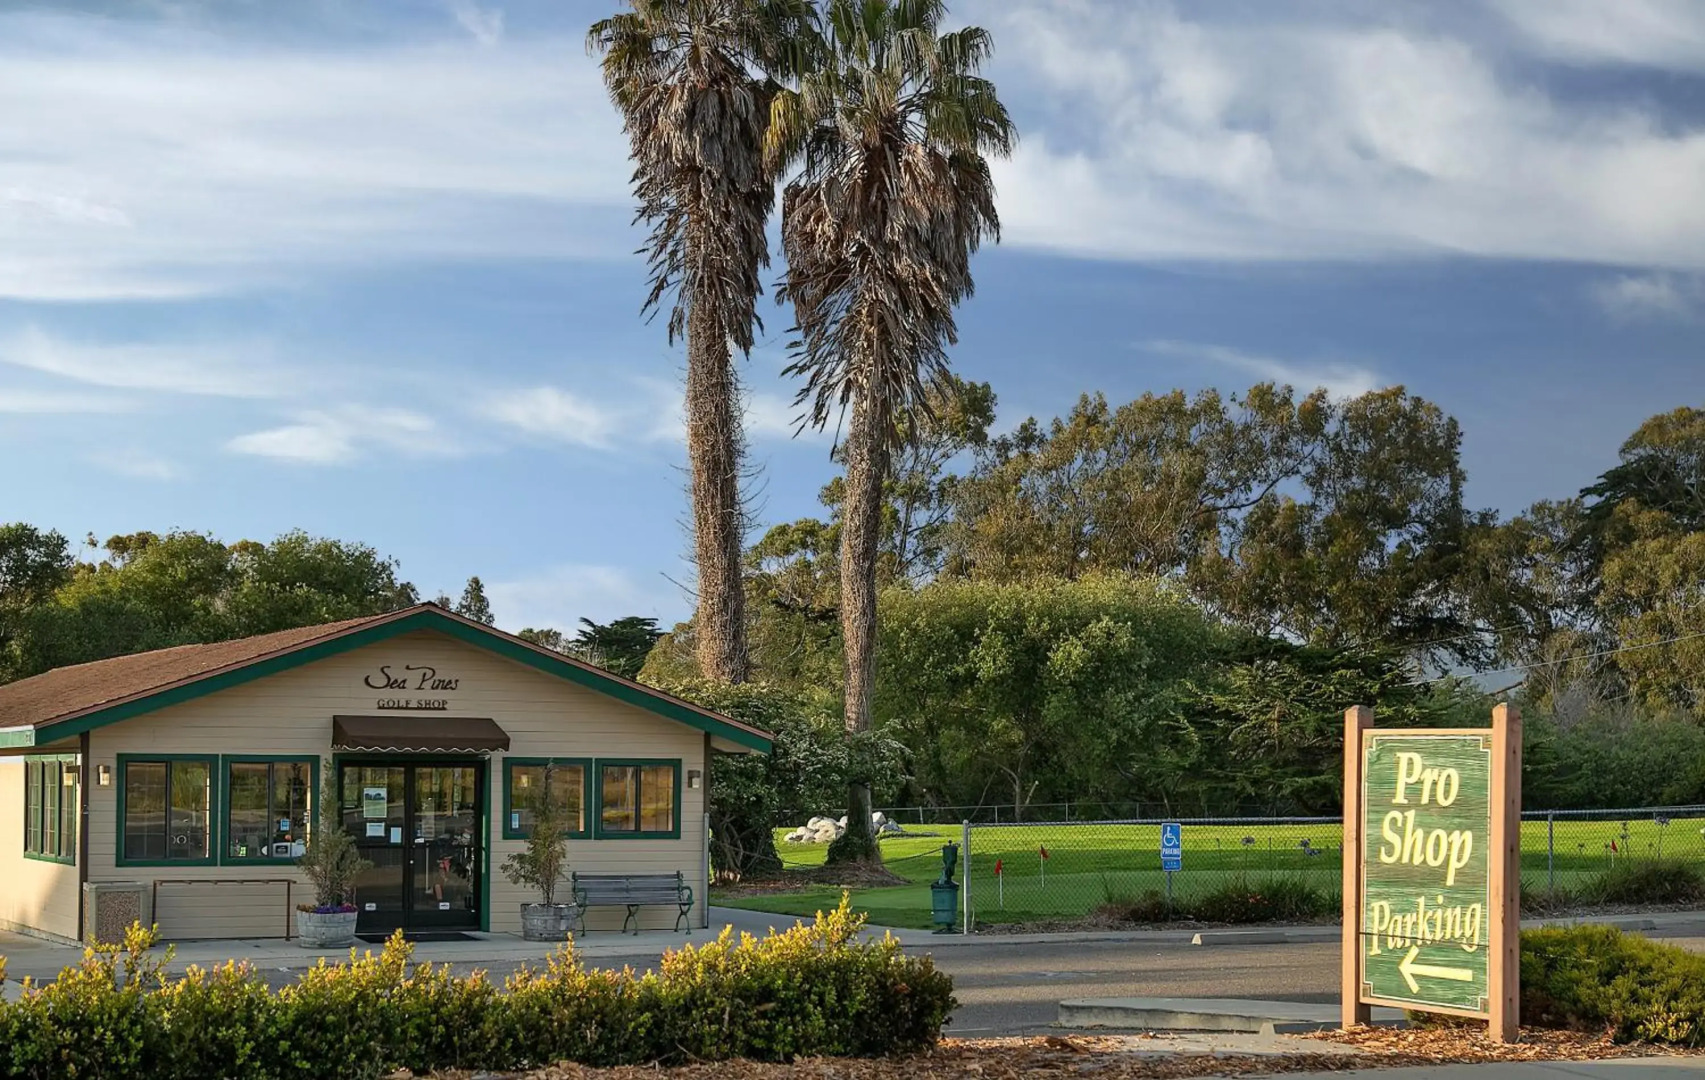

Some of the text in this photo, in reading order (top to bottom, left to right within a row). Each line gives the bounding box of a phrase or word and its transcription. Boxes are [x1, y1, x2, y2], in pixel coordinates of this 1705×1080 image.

[364, 664, 459, 690] Sea Pines
[377, 699, 448, 709] GOLF SHOP
[1391, 751, 1459, 807] Pro
[1379, 809, 1473, 886] Shop
[1369, 894, 1482, 956] Parking
